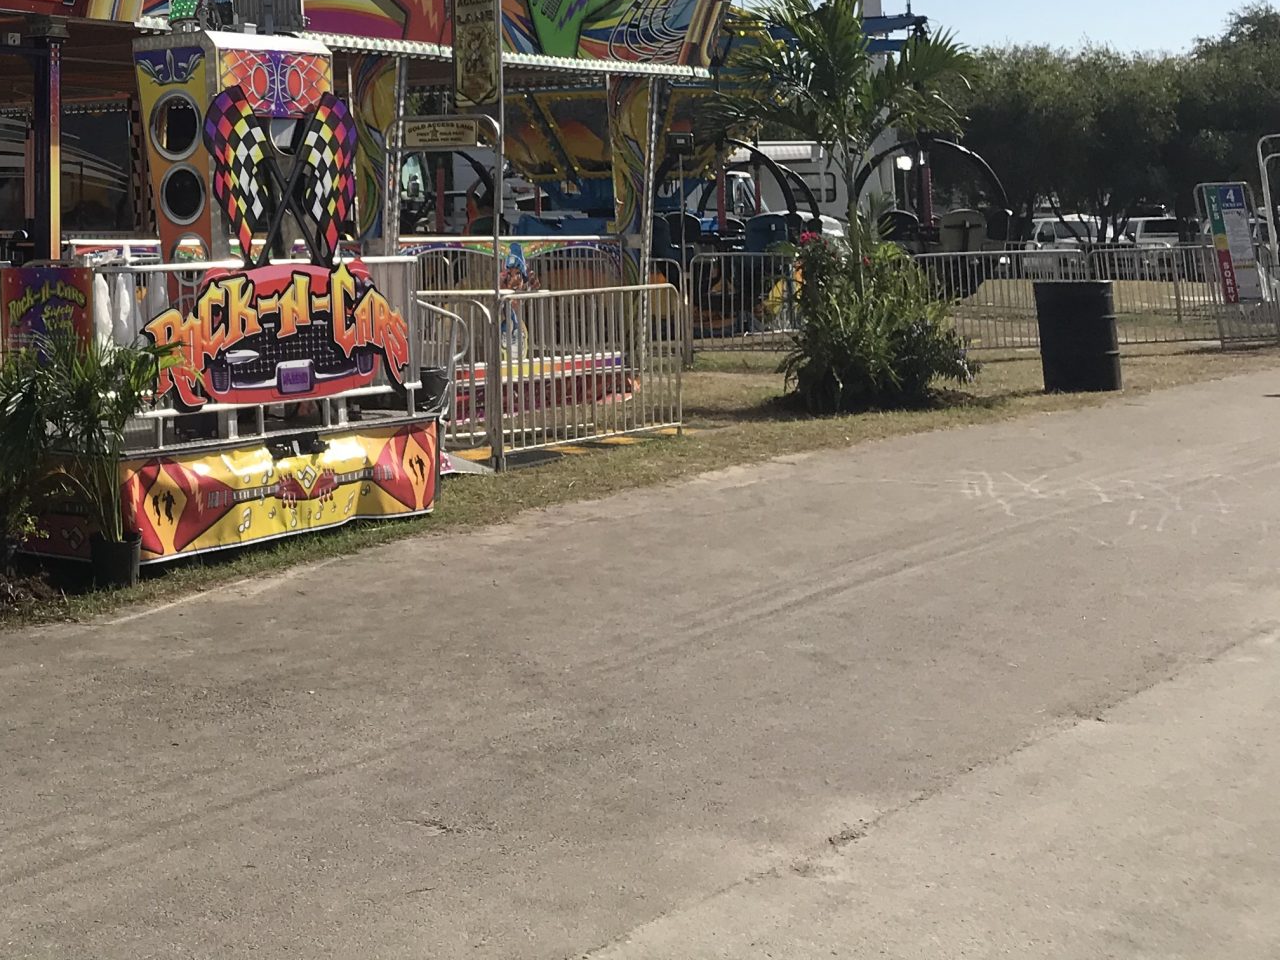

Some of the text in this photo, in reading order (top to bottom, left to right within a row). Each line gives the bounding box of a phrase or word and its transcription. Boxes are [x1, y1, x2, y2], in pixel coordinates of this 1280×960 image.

[1210, 195, 1220, 220] YES
[1226, 189, 1235, 203] 4
[1222, 262, 1235, 302] SORRY
